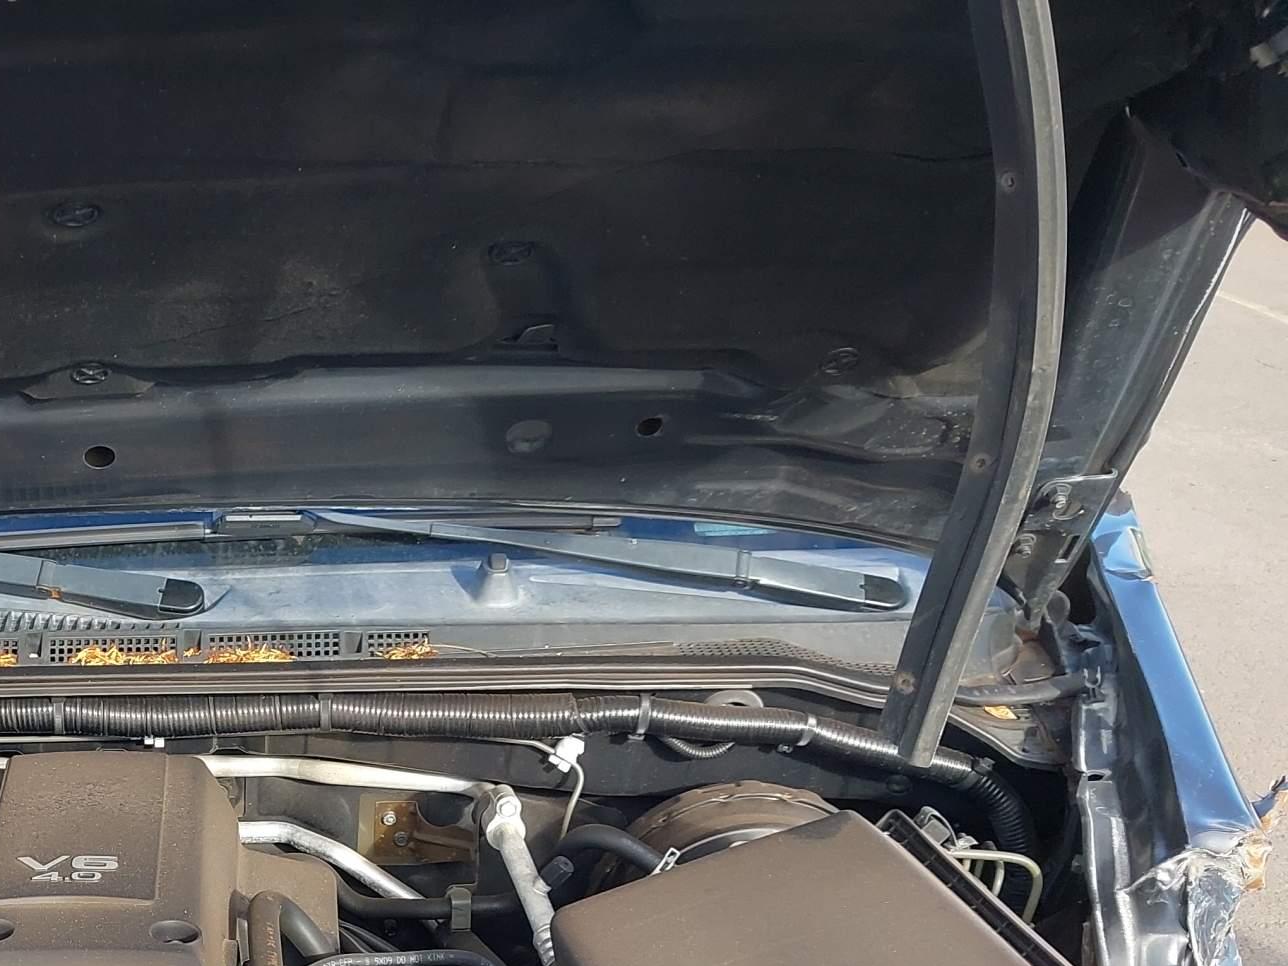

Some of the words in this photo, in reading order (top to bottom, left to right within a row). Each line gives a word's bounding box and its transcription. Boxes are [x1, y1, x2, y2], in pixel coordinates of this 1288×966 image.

[16, 855, 119, 871] V6
[30, 871, 103, 882] 4.0
[396, 956, 407, 965] DO
